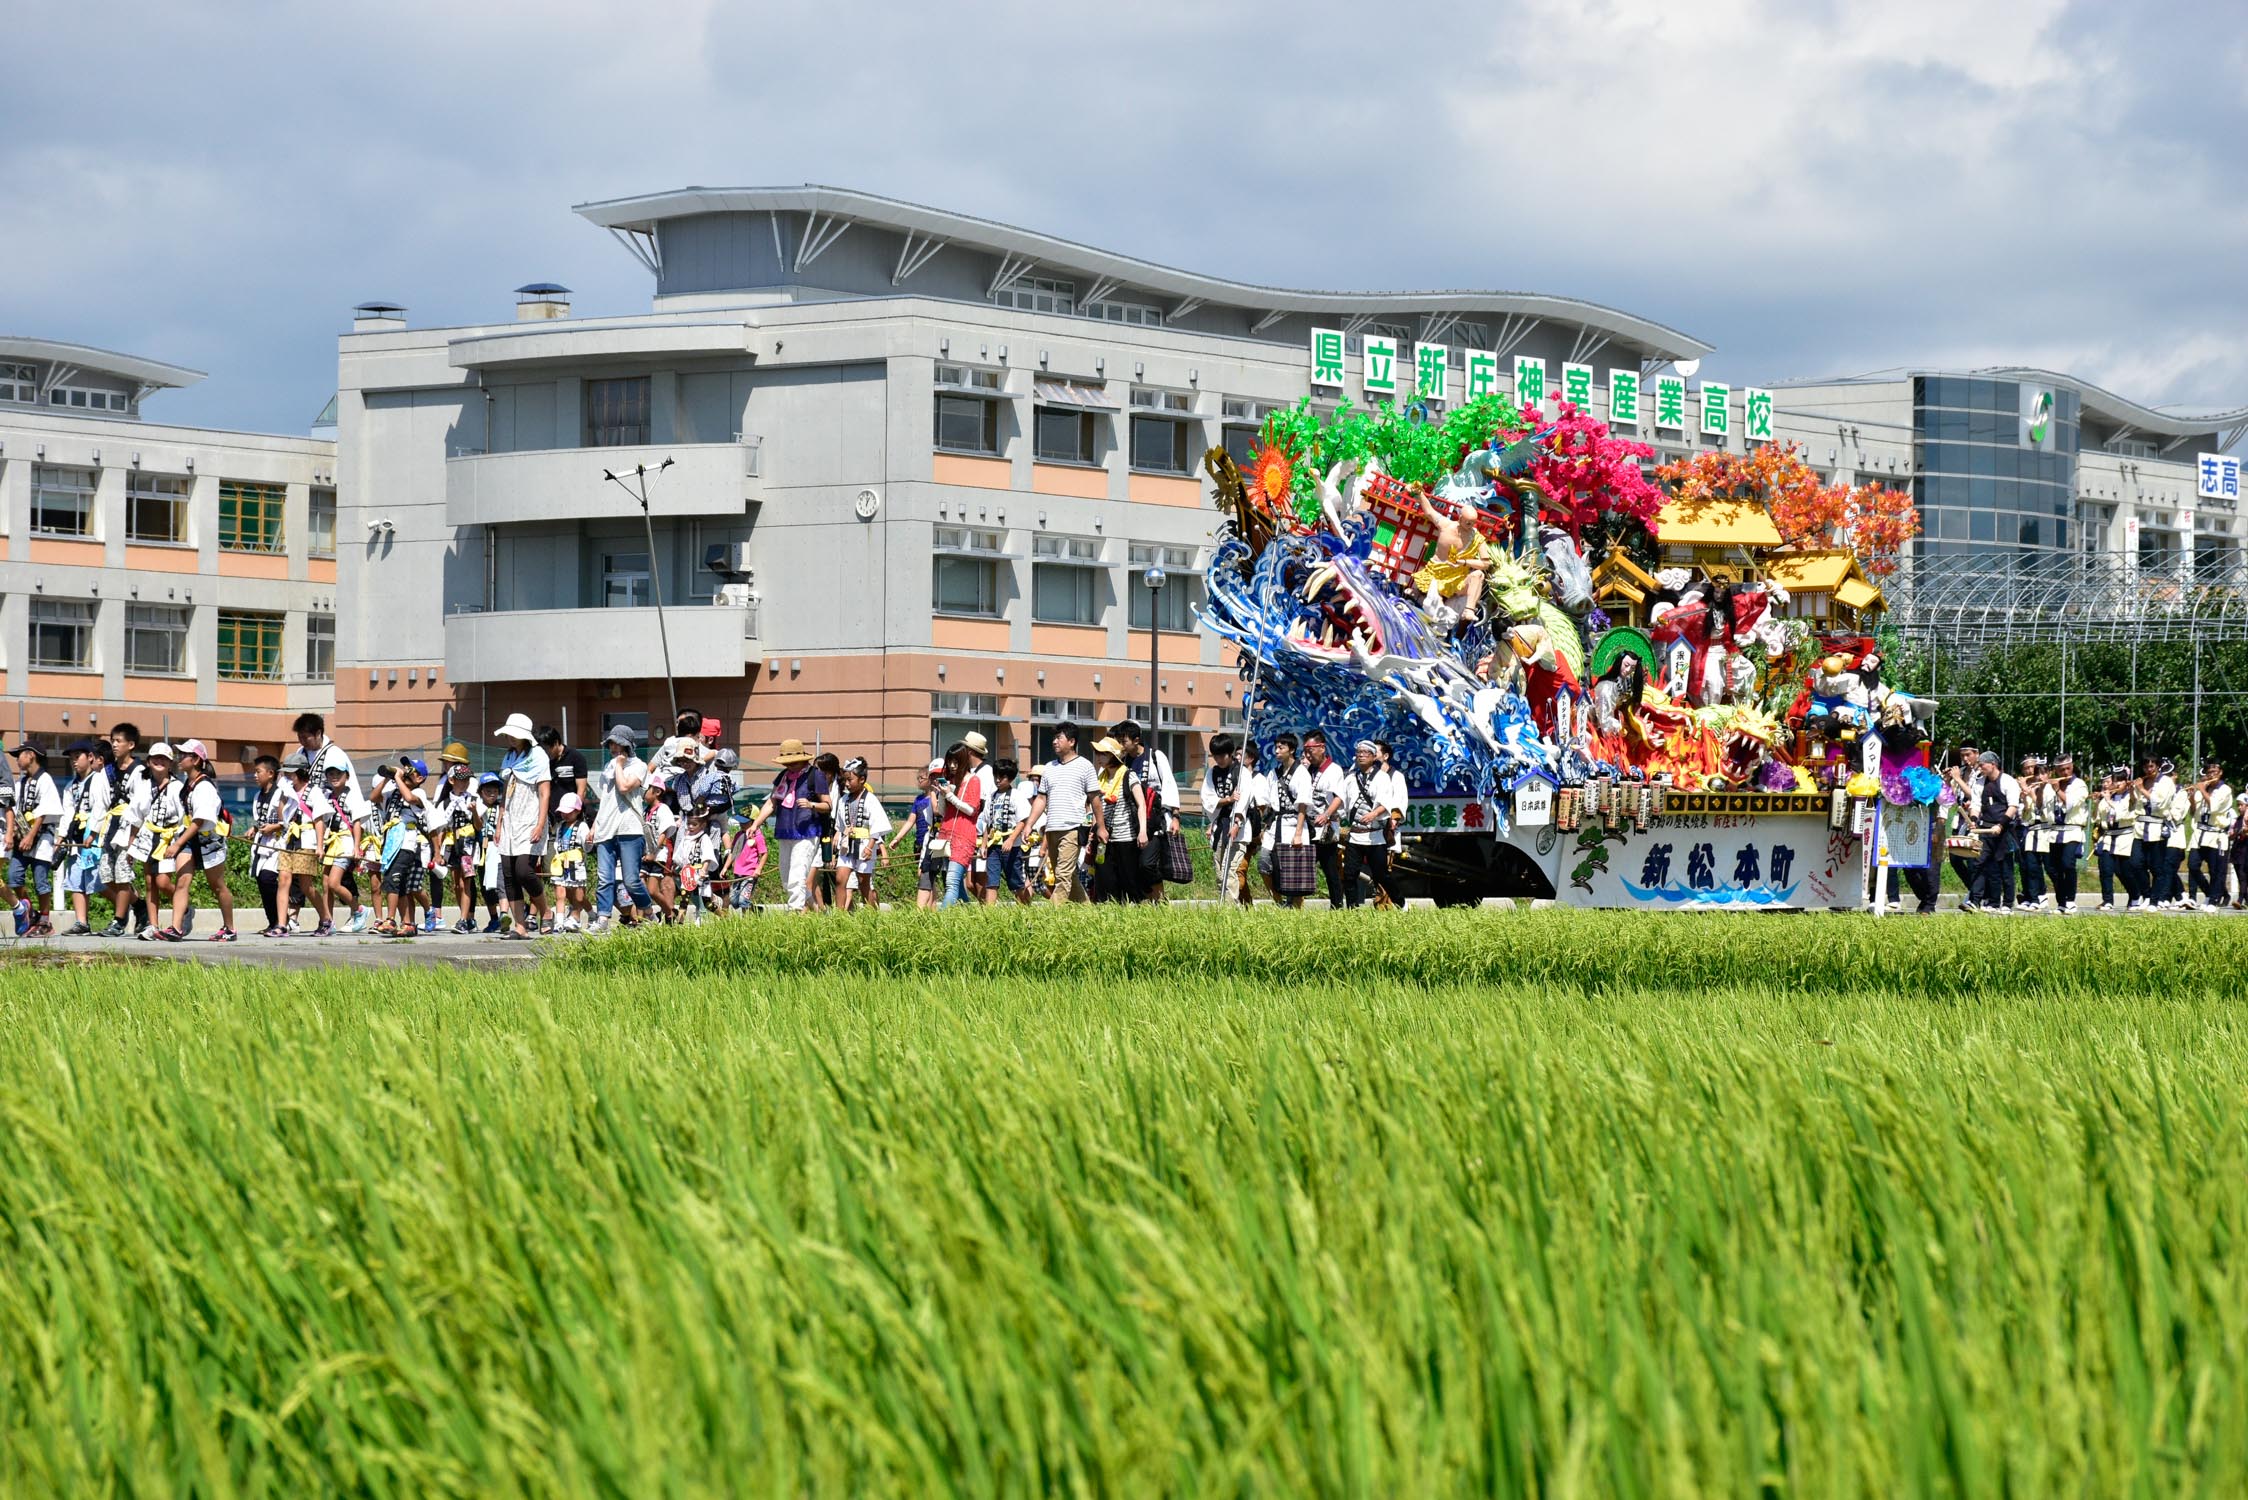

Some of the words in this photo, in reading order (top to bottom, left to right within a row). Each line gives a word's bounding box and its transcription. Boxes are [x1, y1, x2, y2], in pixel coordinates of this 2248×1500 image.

[1315, 332, 1771, 438] 県立新庄神室産業高校
[1675, 650, 1685, 691] 景行皇
[1462, 803, 1485, 828] 祭
[1521, 800, 1547, 811] 日本武尊
[1640, 843, 1795, 889] 新松本町
